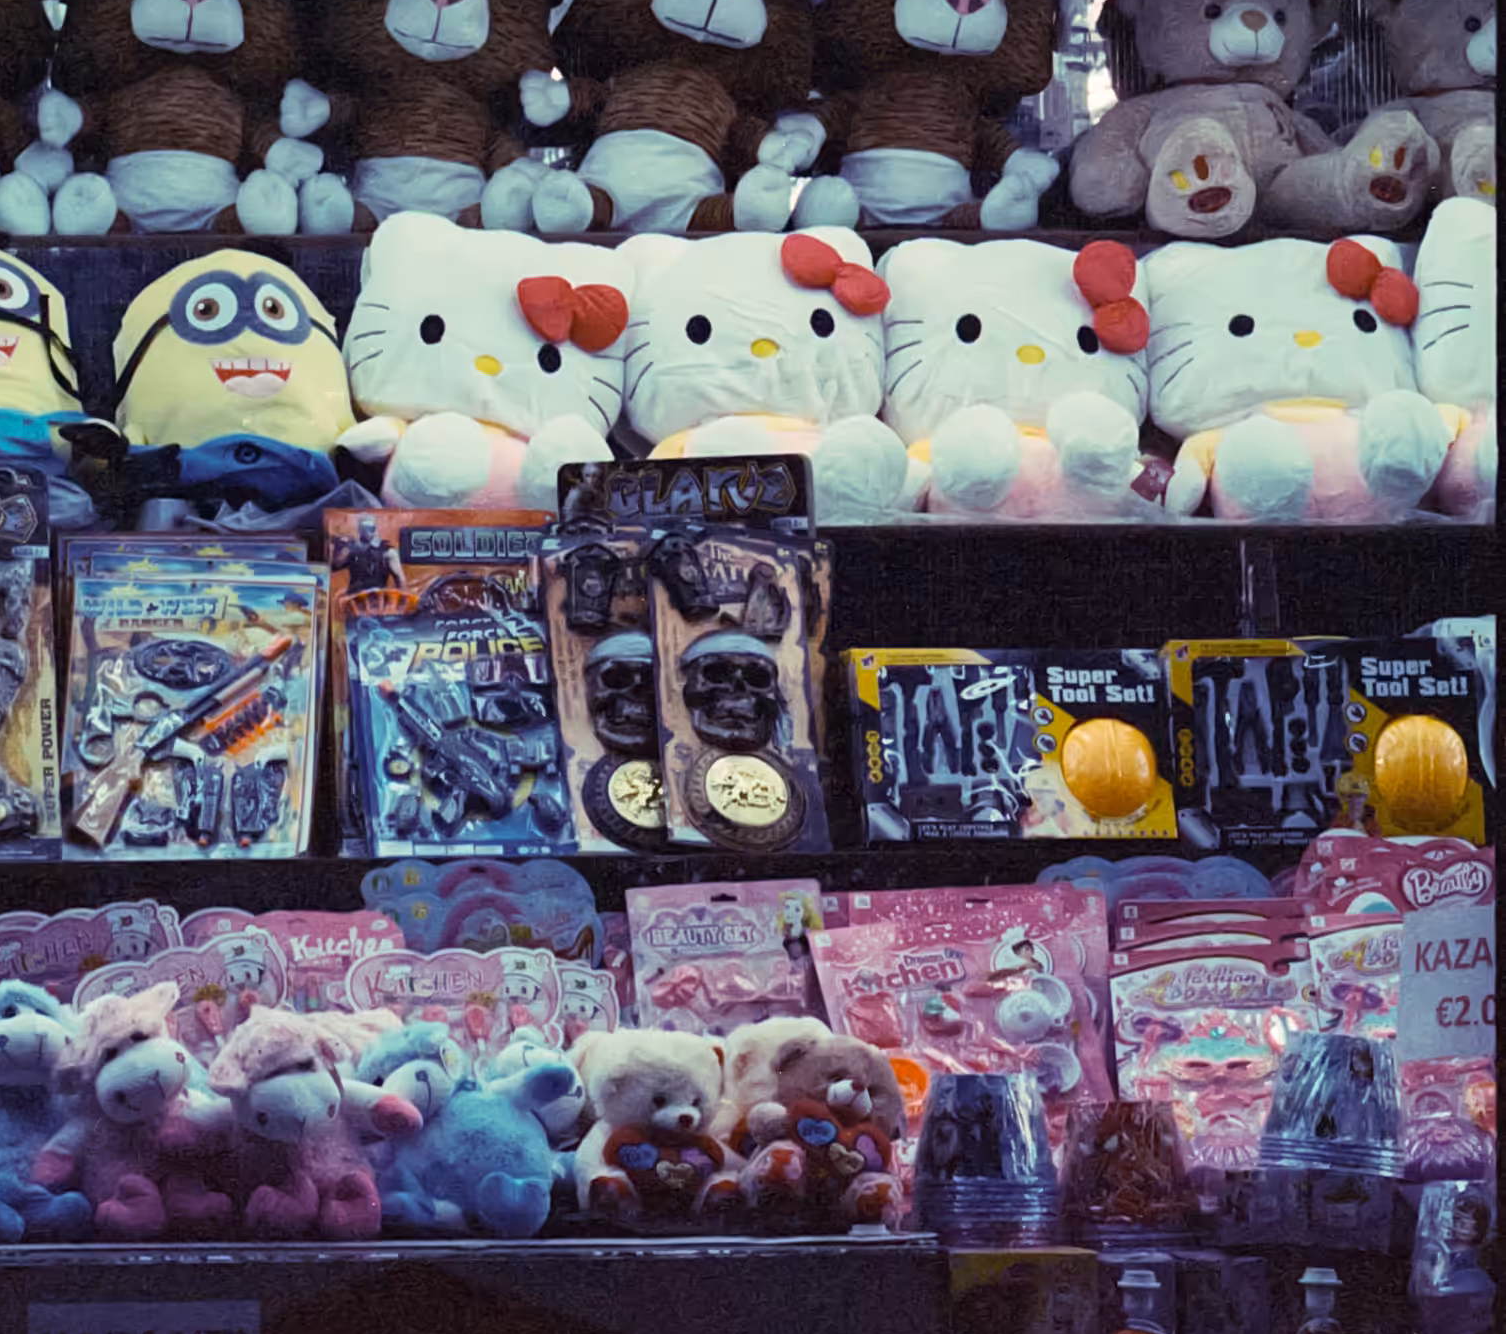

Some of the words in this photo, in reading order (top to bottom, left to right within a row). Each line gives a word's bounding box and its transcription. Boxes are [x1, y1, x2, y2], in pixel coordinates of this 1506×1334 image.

[1046, 666, 1119, 687] Super
[1360, 656, 1433, 679] Super
[1048, 684, 1097, 703] Tool
[1105, 683, 1156, 703] Set!
[1361, 676, 1410, 697] Tool
[1418, 675, 1469, 697] Set!
[39, 697, 55, 762] POWER
